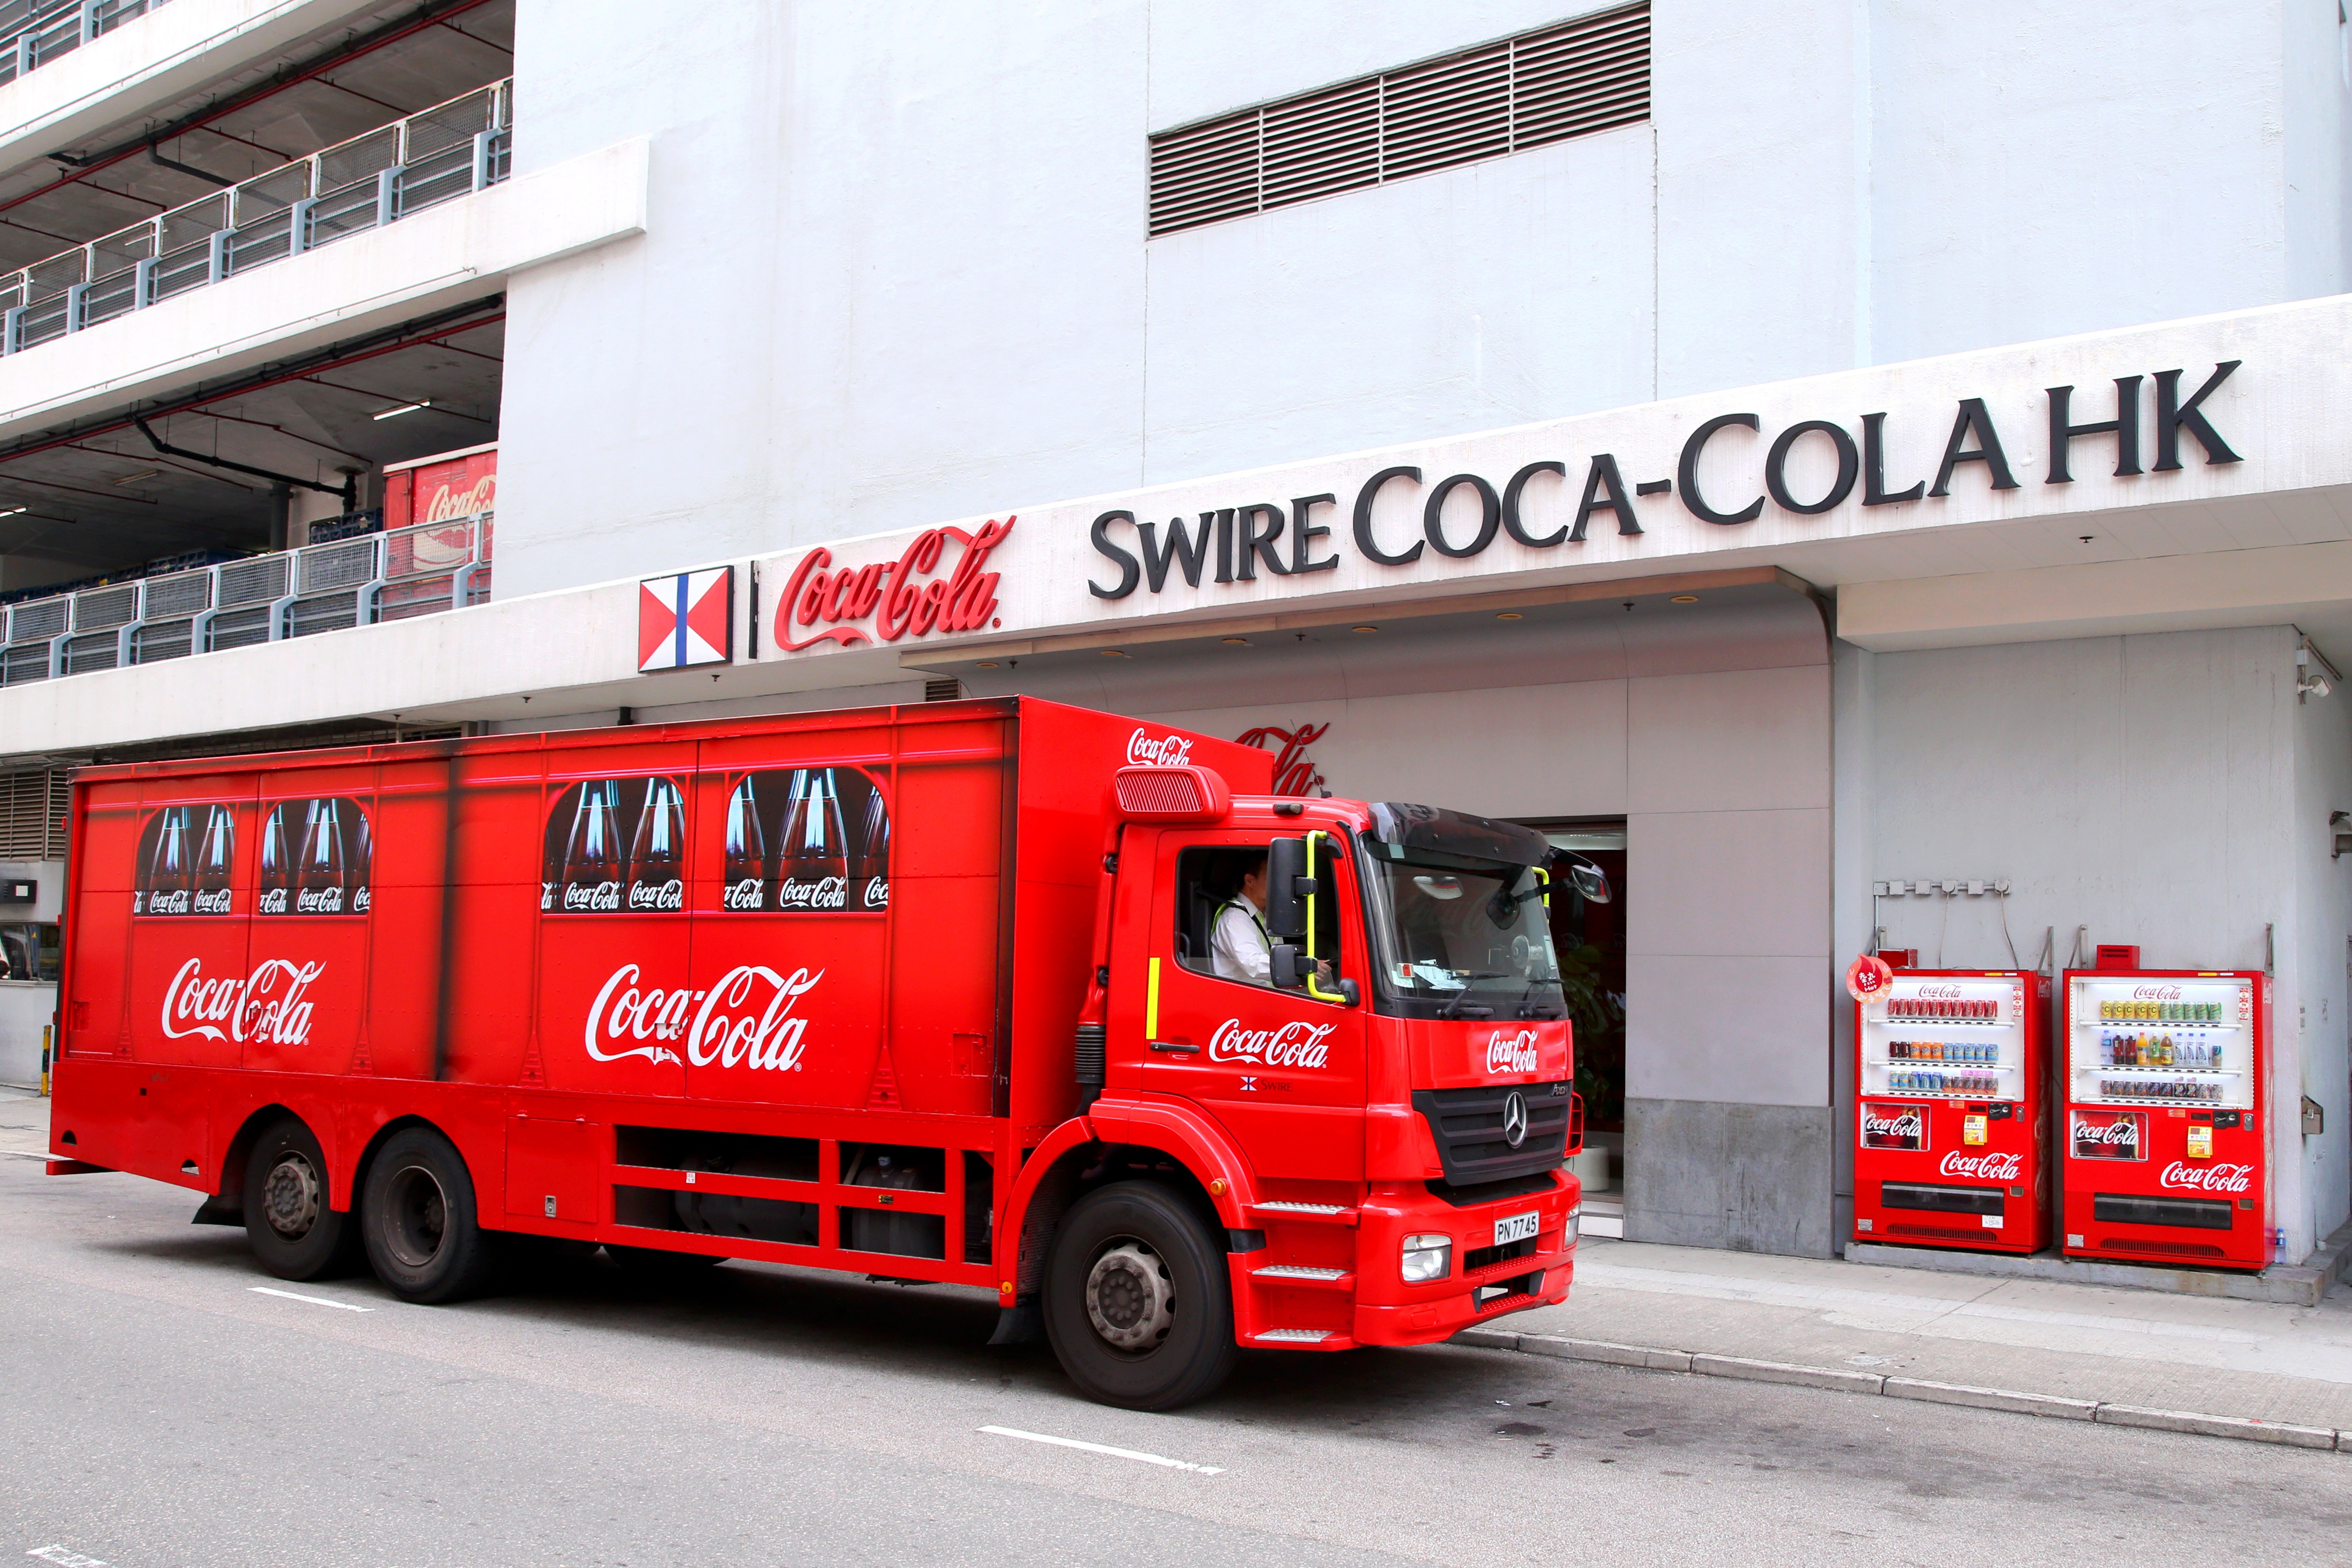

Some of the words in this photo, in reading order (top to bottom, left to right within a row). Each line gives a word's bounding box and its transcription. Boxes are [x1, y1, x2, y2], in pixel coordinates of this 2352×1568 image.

[1089, 493, 1339, 600] SWIRE
[1352, 398, 2021, 566] COCA-COLA
[2044, 360, 2244, 485] HK
[774, 515, 1017, 652] Coca-Cola
[150, 890, 189, 914] Coca-Cola
[297, 887, 343, 912] Coca-Cola
[564, 881, 620, 910] Coca-Cola
[779, 876, 846, 908] Coca-Cola
[1859, 972, 1876, 986] 熱
[1864, 984, 1878, 992] Hot
[1918, 983, 1962, 998] Coca-Cola
[2133, 984, 2183, 1000] Coca-Cola
[161, 957, 327, 1046] Coca-Cola
[584, 963, 826, 1072] Coca-Cola
[1208, 1018, 1338, 1069] Coca-Cola
[1486, 1029, 1539, 1074] Coca-Cola
[1261, 1079, 1293, 1092] SWIRE
[1939, 1150, 2024, 1180] Coca-Cola
[2160, 1161, 2255, 1193] Coca-Cola
[1498, 1221, 1510, 1242] PN
[1512, 1215, 1536, 1238] 7745
